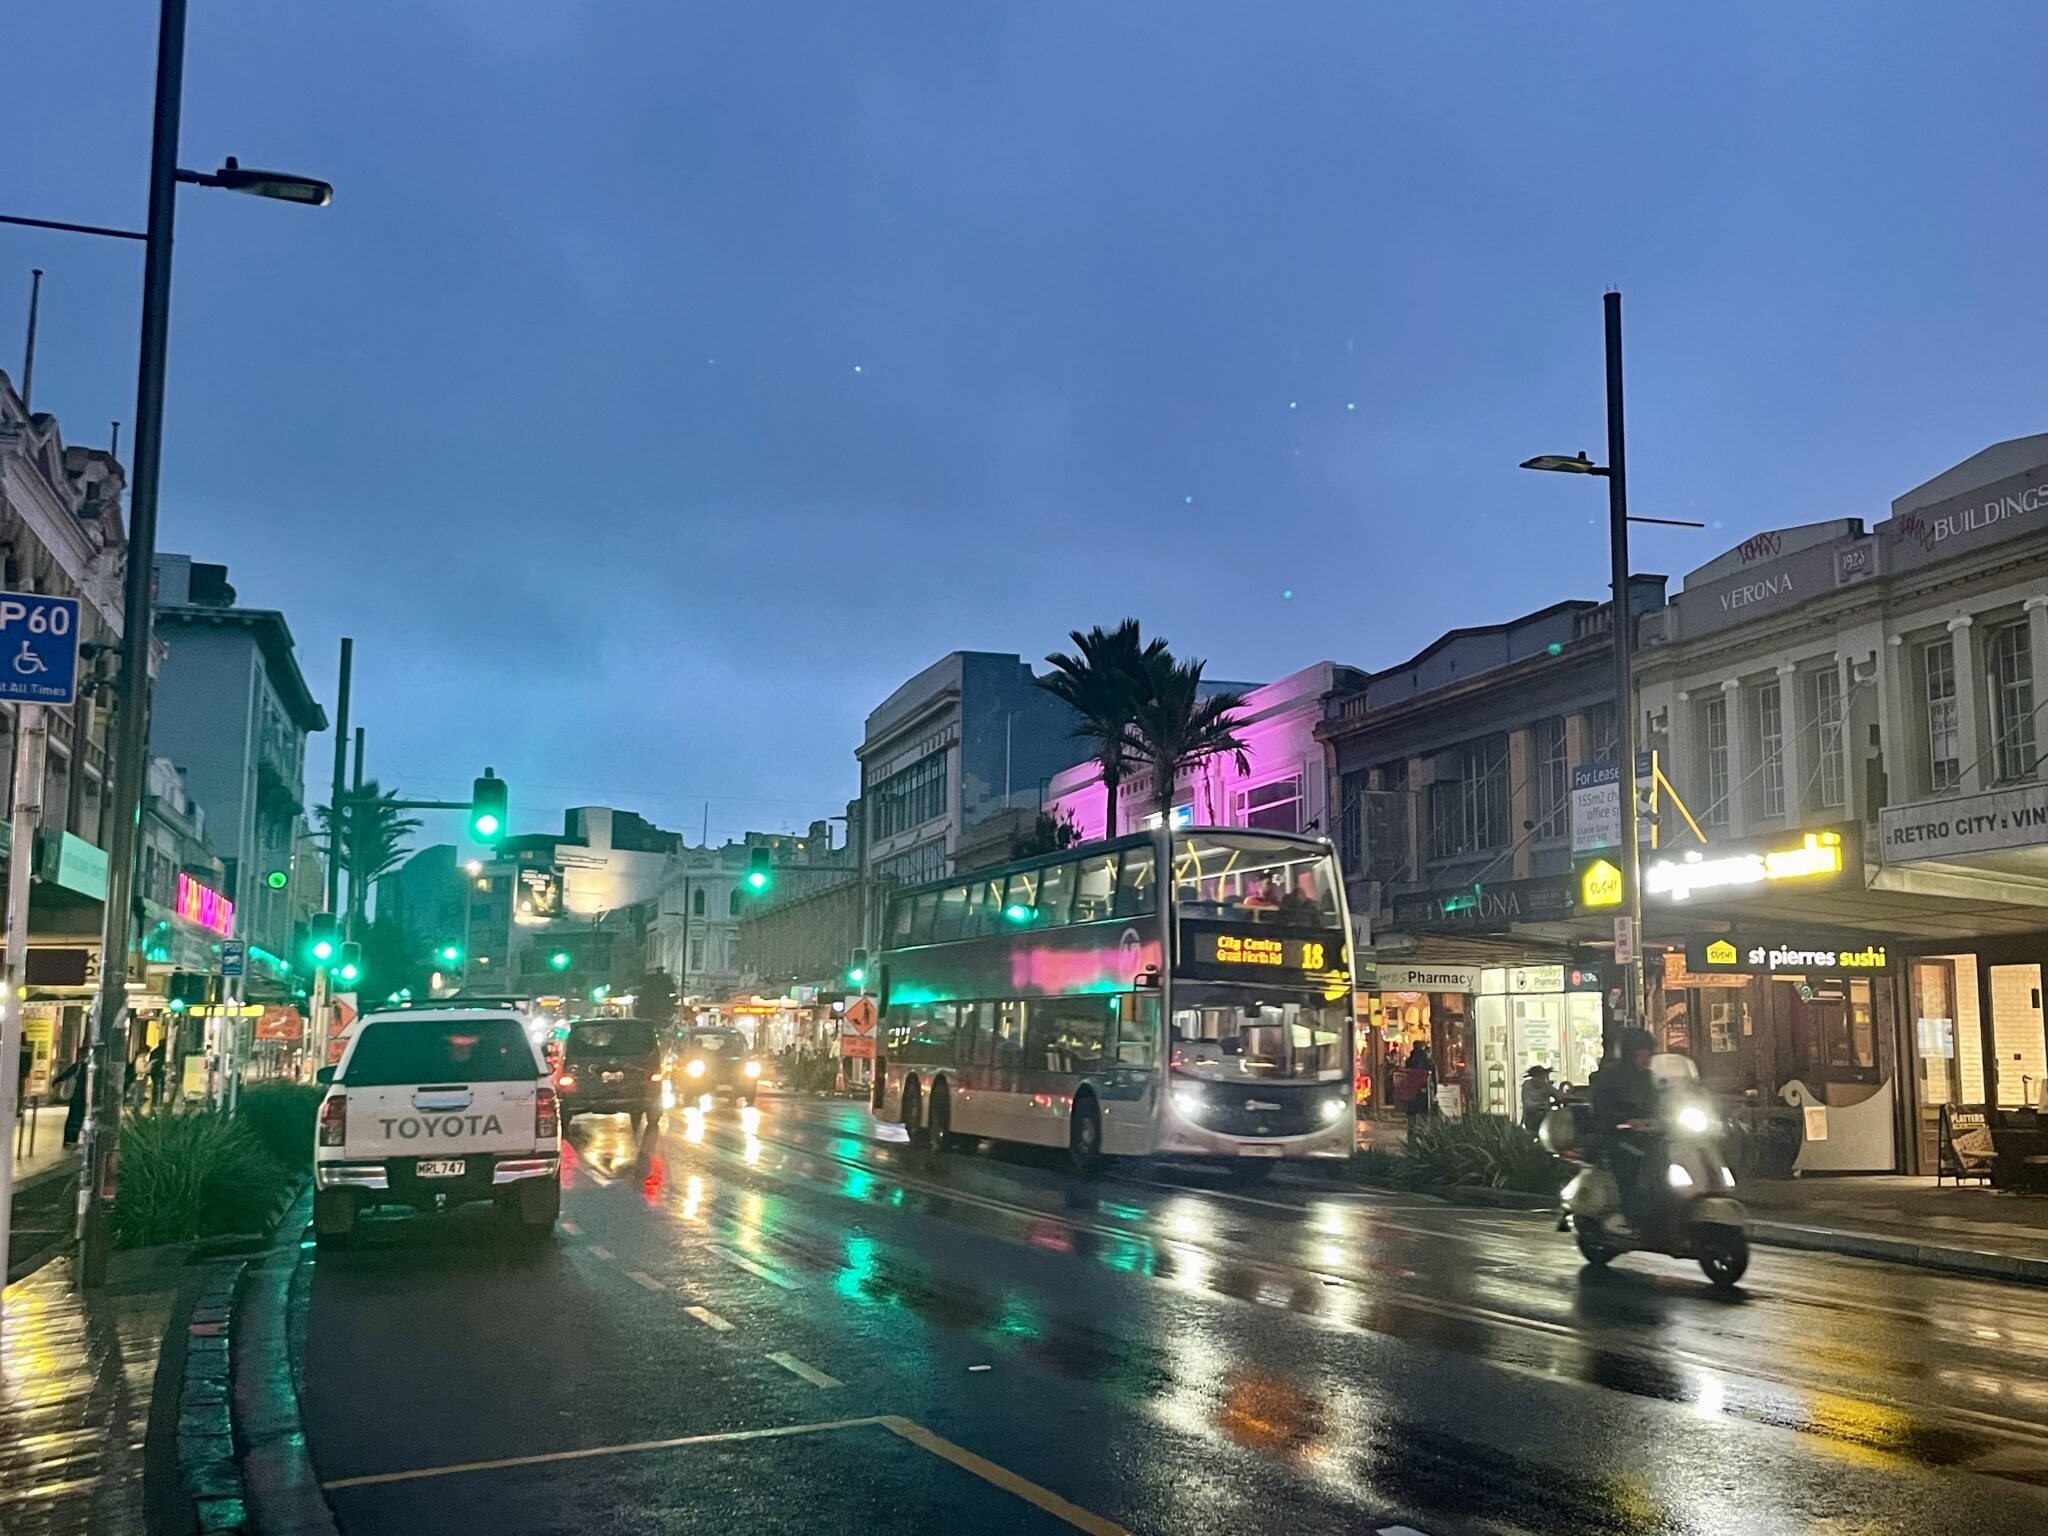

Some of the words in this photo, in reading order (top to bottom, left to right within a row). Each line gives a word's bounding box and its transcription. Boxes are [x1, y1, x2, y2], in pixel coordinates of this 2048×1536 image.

[1934, 484, 2048, 541] BUILDINGS
[1720, 573, 1793, 611] VERONA
[0, 601, 70, 635] P60
[10, 682, 27, 694] All
[31, 683, 66, 696] Times
[1575, 771, 1591, 786] For
[1593, 766, 1620, 783] Lease
[1577, 790, 1606, 808] 155m2
[1587, 808, 1610, 821] office
[1894, 821, 1949, 844] RETRO
[1955, 813, 1997, 836] CITY
[2012, 804, 2048, 828] VIN
[1217, 936, 1241, 950] City
[1244, 938, 1282, 952] Centre
[1269, 952, 1282, 966] Rd
[1301, 943, 1324, 969] 18
[1748, 946, 1767, 965] st
[1769, 944, 1836, 970] pierres
[1839, 946, 1886, 967] sushi
[1408, 971, 1474, 987] Pharmacy
[379, 1114, 503, 1139] TOYOTA
